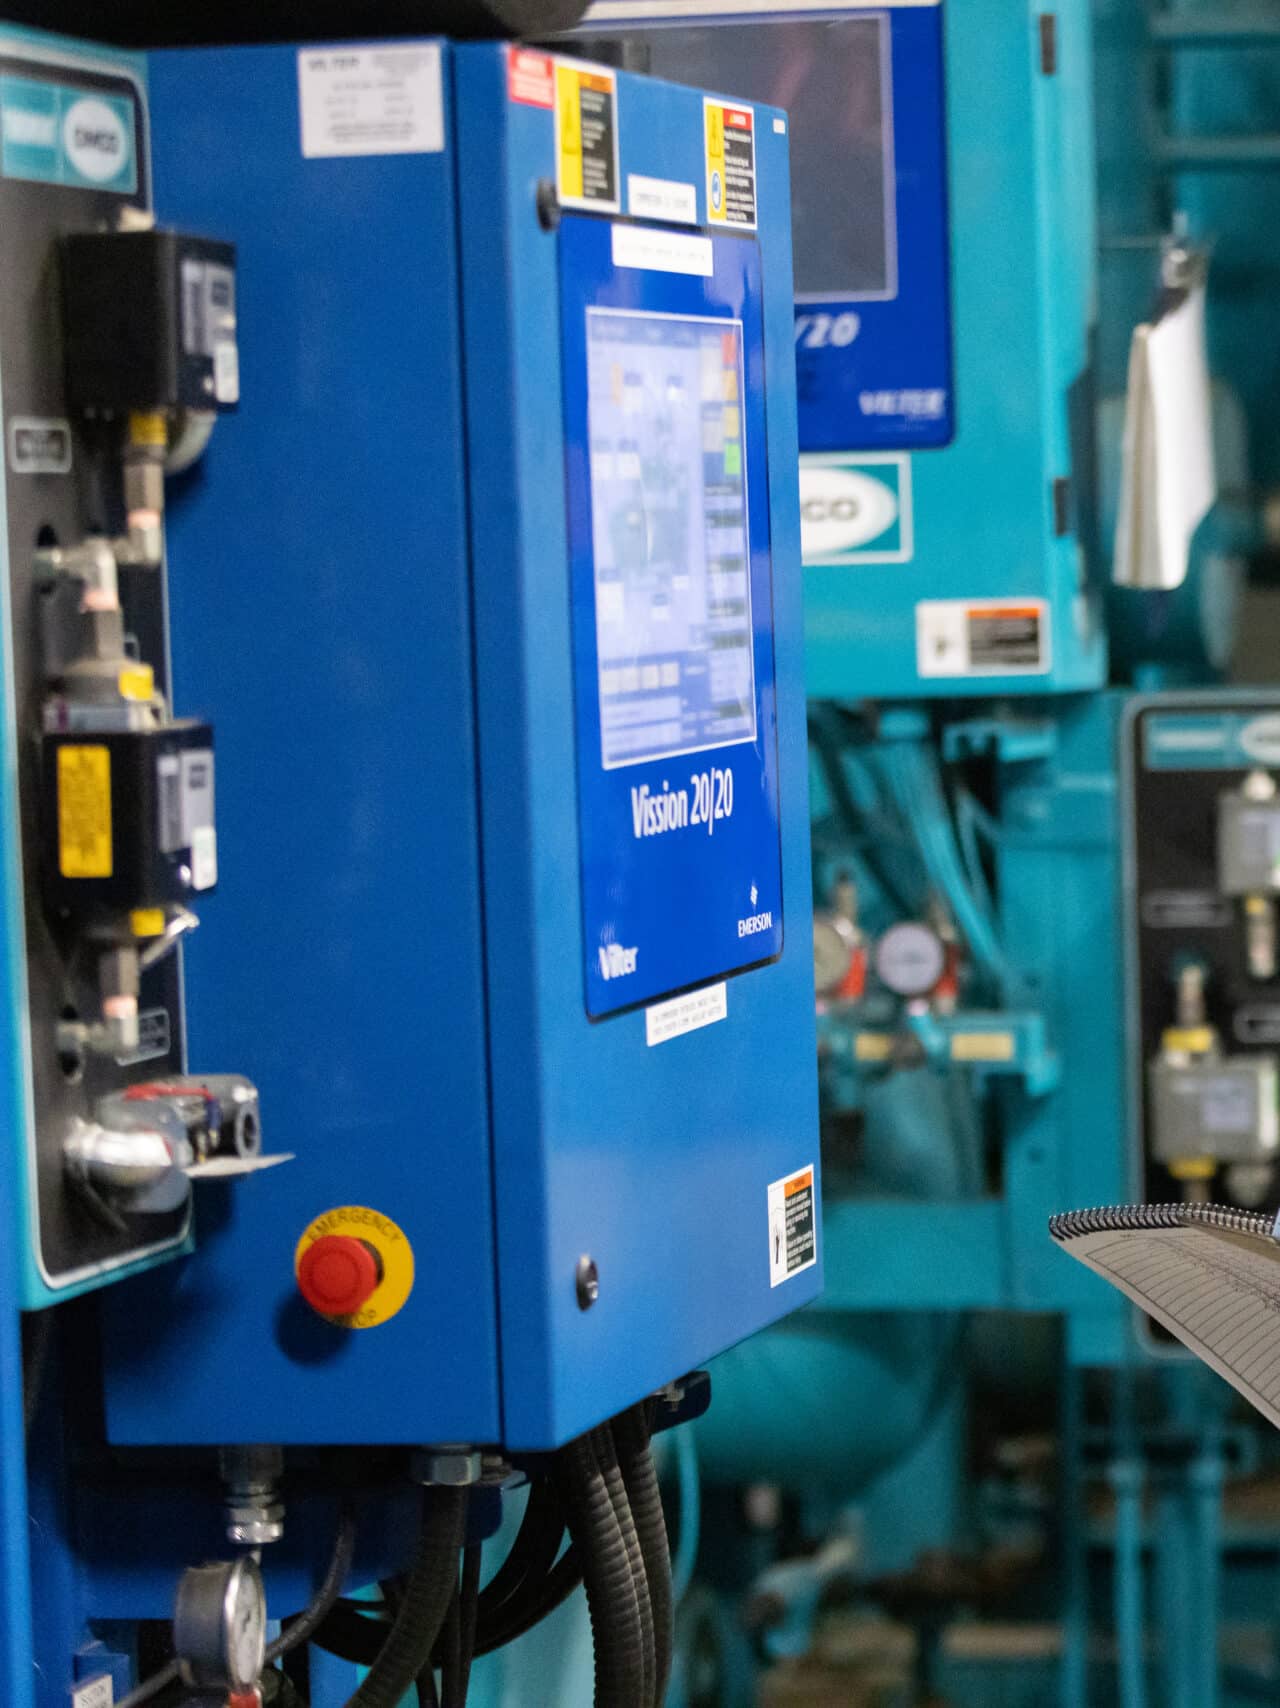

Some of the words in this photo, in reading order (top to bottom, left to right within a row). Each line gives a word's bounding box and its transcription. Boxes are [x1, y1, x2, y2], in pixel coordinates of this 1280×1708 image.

[631, 780, 688, 838] Vission
[690, 767, 733, 836] 20/20
[738, 912, 772, 938] EMERSON
[307, 1209, 400, 1242] EMERGENCY
